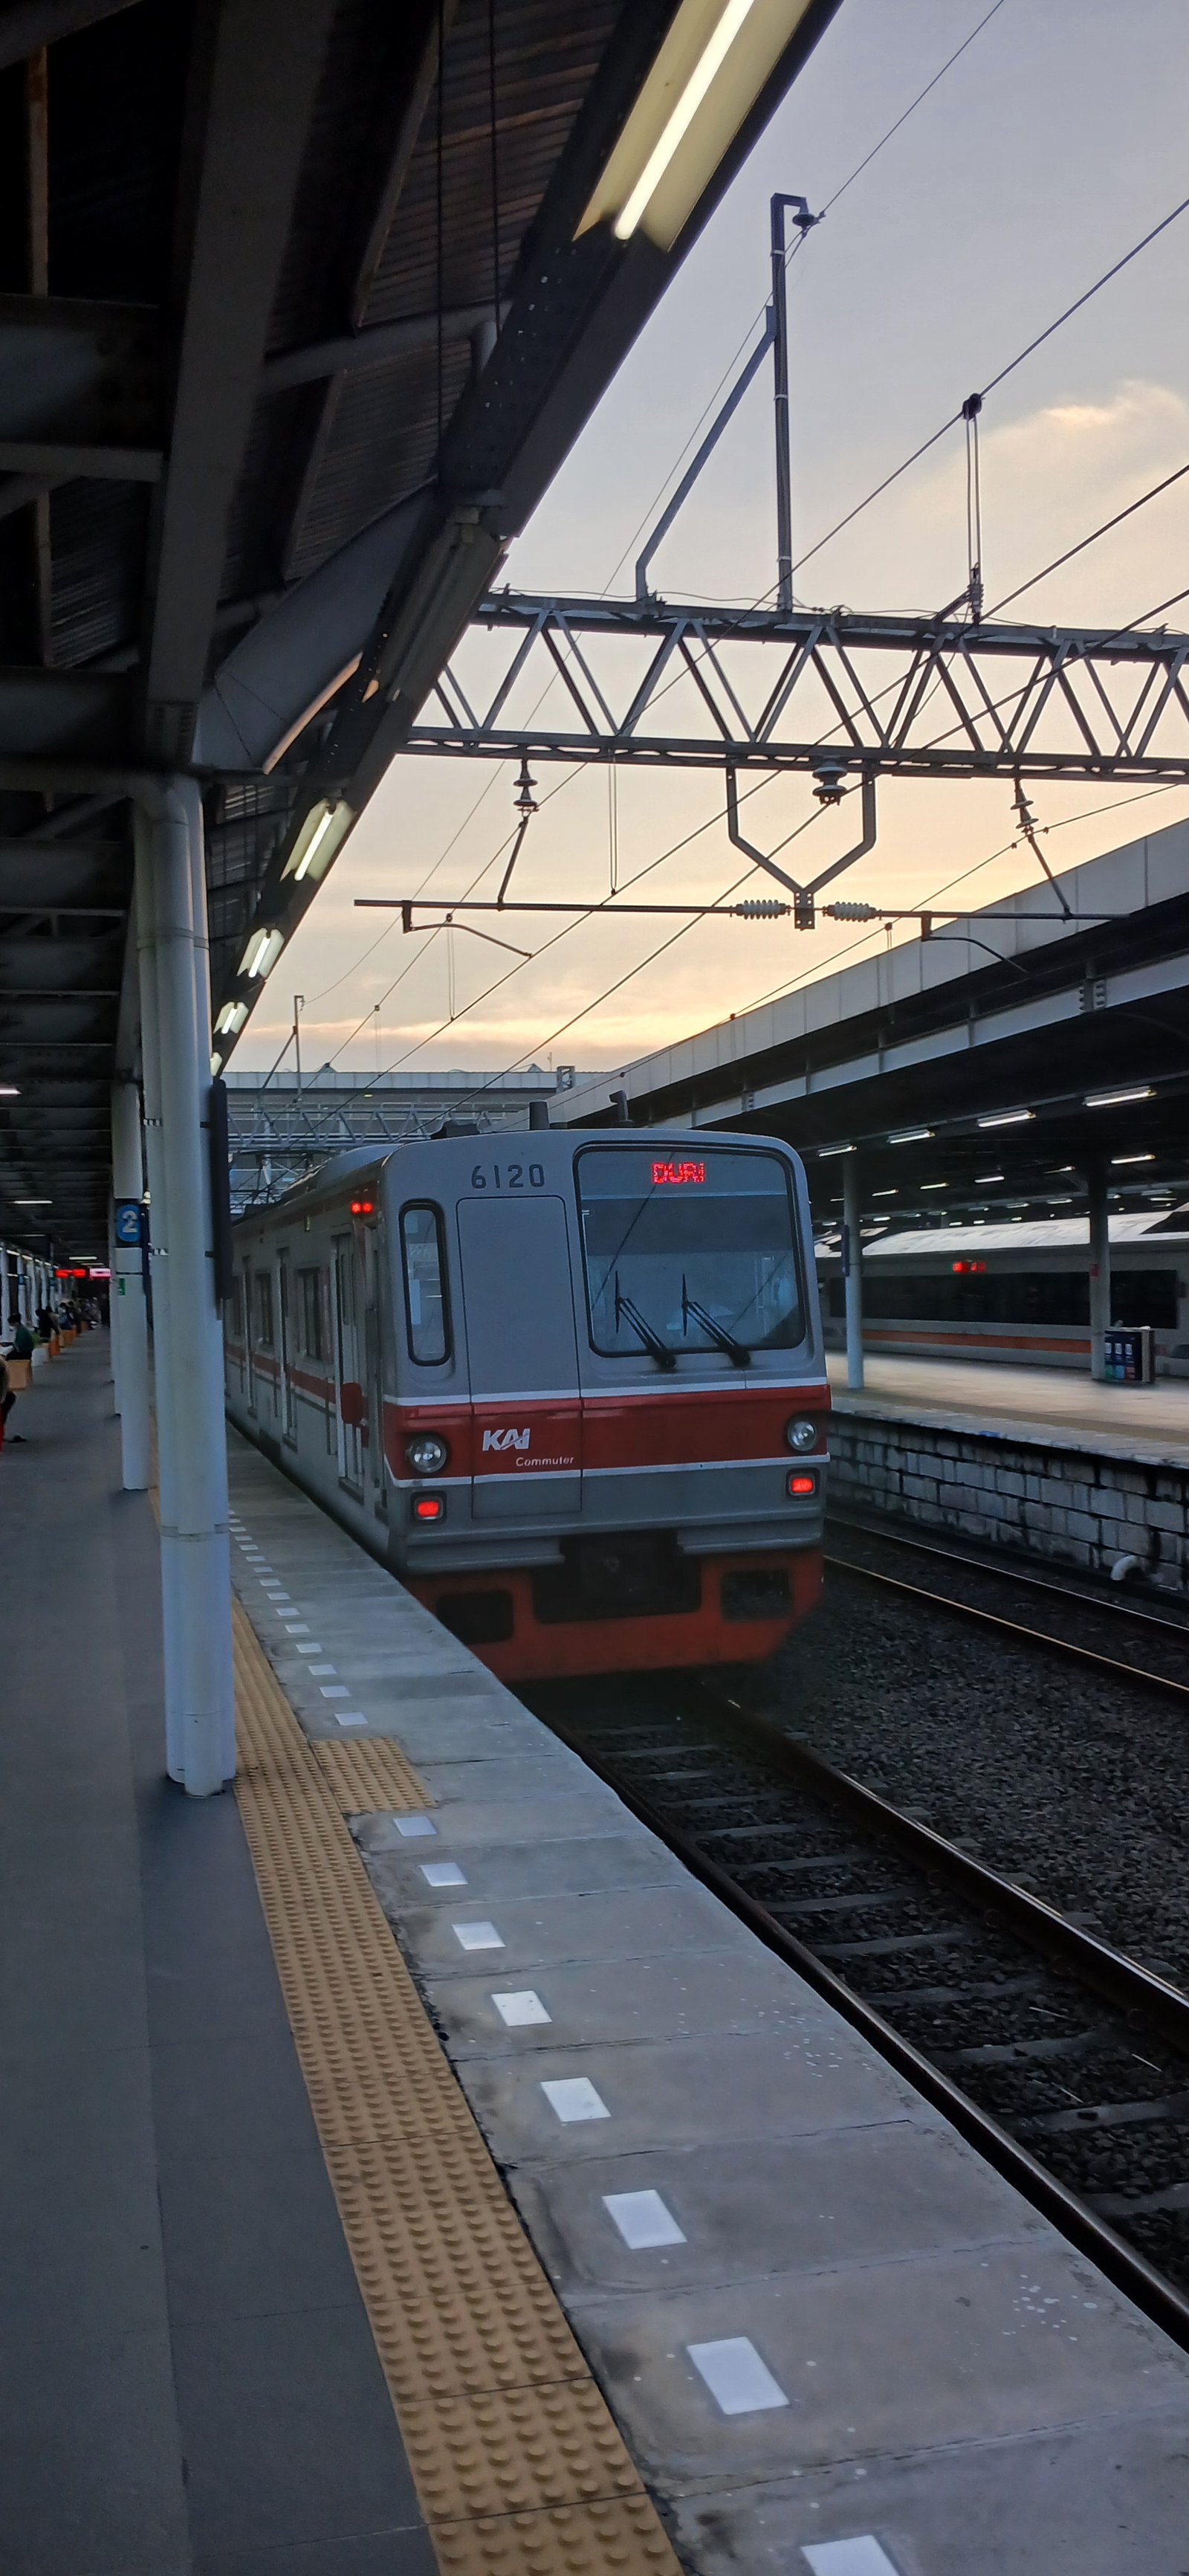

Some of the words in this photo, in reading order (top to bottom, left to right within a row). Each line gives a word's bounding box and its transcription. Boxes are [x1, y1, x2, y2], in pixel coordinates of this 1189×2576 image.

[471, 1163, 545, 1189] 6120
[652, 1162, 705, 1184] DURI
[122, 1210, 138, 1233] 2
[482, 1428, 531, 1451] KAI
[516, 1456, 574, 1467] Commuter
